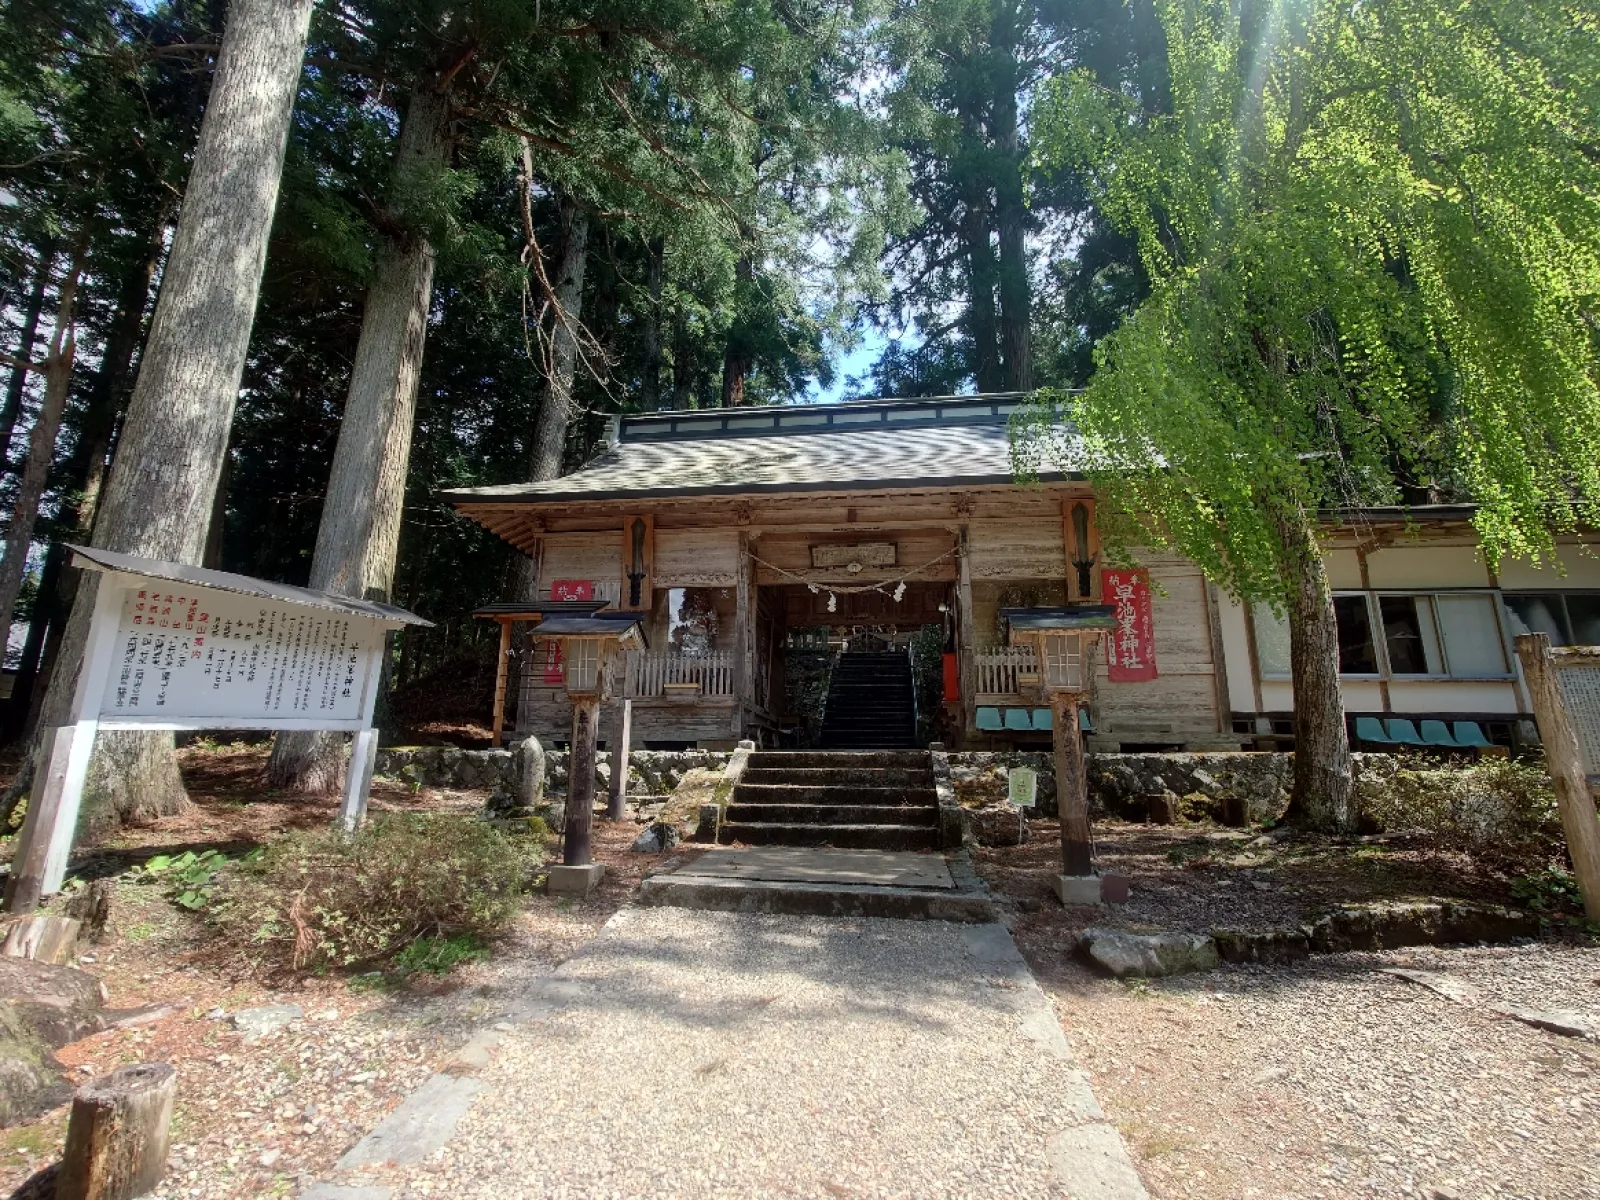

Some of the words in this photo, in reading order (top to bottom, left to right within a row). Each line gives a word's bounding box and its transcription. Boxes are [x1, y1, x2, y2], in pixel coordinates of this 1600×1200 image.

[1113, 584, 1144, 669] 早池峯神社
